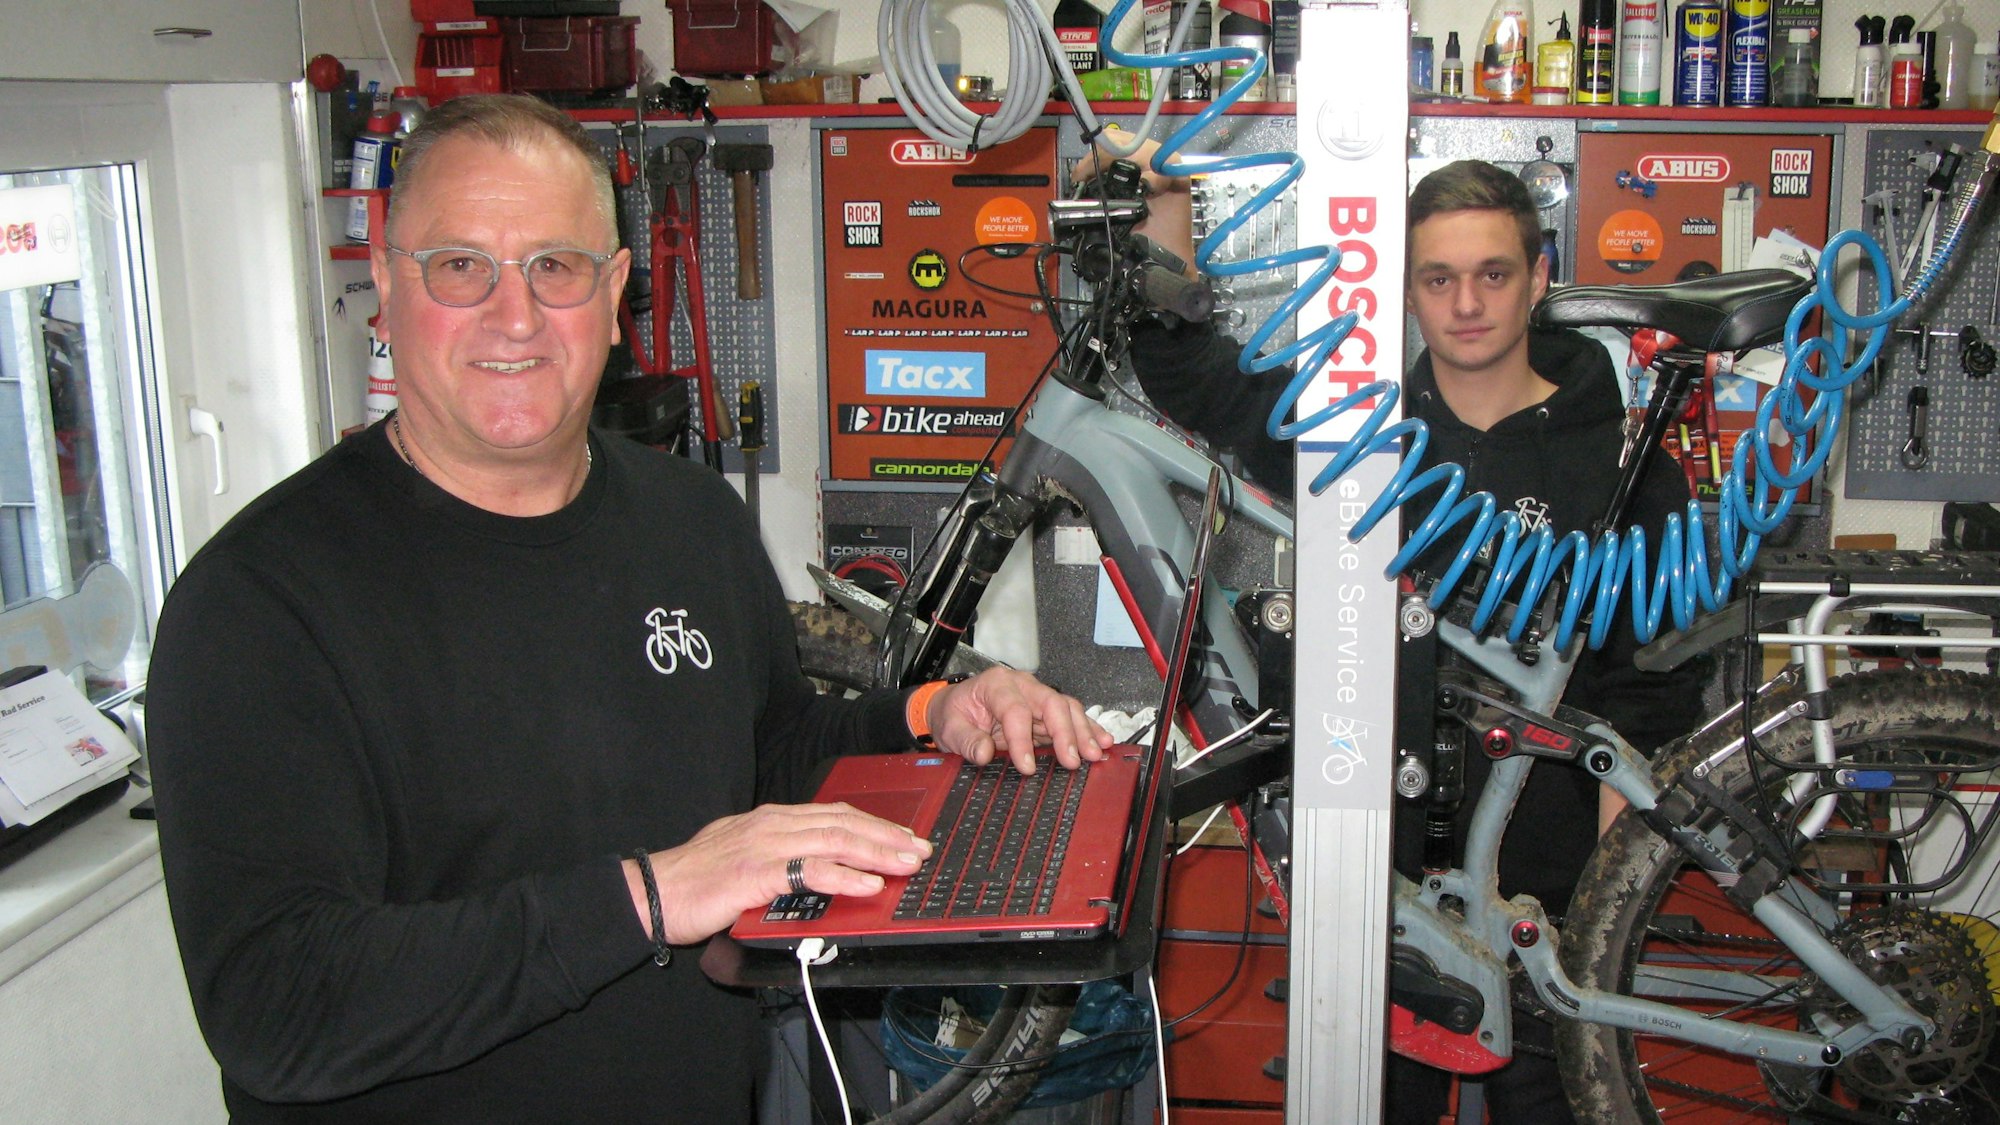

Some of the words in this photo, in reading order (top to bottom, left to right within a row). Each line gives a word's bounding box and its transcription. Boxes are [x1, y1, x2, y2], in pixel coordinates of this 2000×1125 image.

[1688, 13, 1718, 25] WD-40
[1777, 7, 1804, 15] GREASE
[1805, 7, 1820, 15] GUN
[1067, 53, 1093, 61] BELESS
[1073, 61, 1092, 70] LANT
[902, 144, 967, 161] ABUS
[1649, 160, 1720, 178] ABUS
[1774, 152, 1808, 172] ROCK
[1772, 174, 1808, 196] SHOX
[847, 205, 878, 223] ROCK
[908, 207, 941, 217] ROCKSHOX
[989, 216, 1002, 224] WE
[1002, 216, 1024, 224] MOVE
[847, 226, 880, 245] SHOX
[983, 224, 1006, 232] PEOPLE
[1007, 224, 1030, 232] BETTER
[1613, 230, 1626, 238] WE
[1627, 230, 1649, 238] MOVE
[1681, 224, 1717, 235] ROCKSHOX
[1606, 238, 1631, 246] PEOPLE
[345, 280, 376, 294] SCHW
[872, 299, 988, 319] MAGURA
[1328, 196, 1378, 410] BOSCH
[877, 357, 974, 390] Tacx
[883, 405, 952, 434] bike
[953, 410, 1005, 427] ahead
[1338, 478, 1366, 571] eBike
[1337, 584, 1366, 703] Service
[1, 705, 17, 718] Rad
[17, 694, 46, 712] Service
[1522, 723, 1573, 750] 160
[1651, 1017, 1682, 1031] BOSCH
